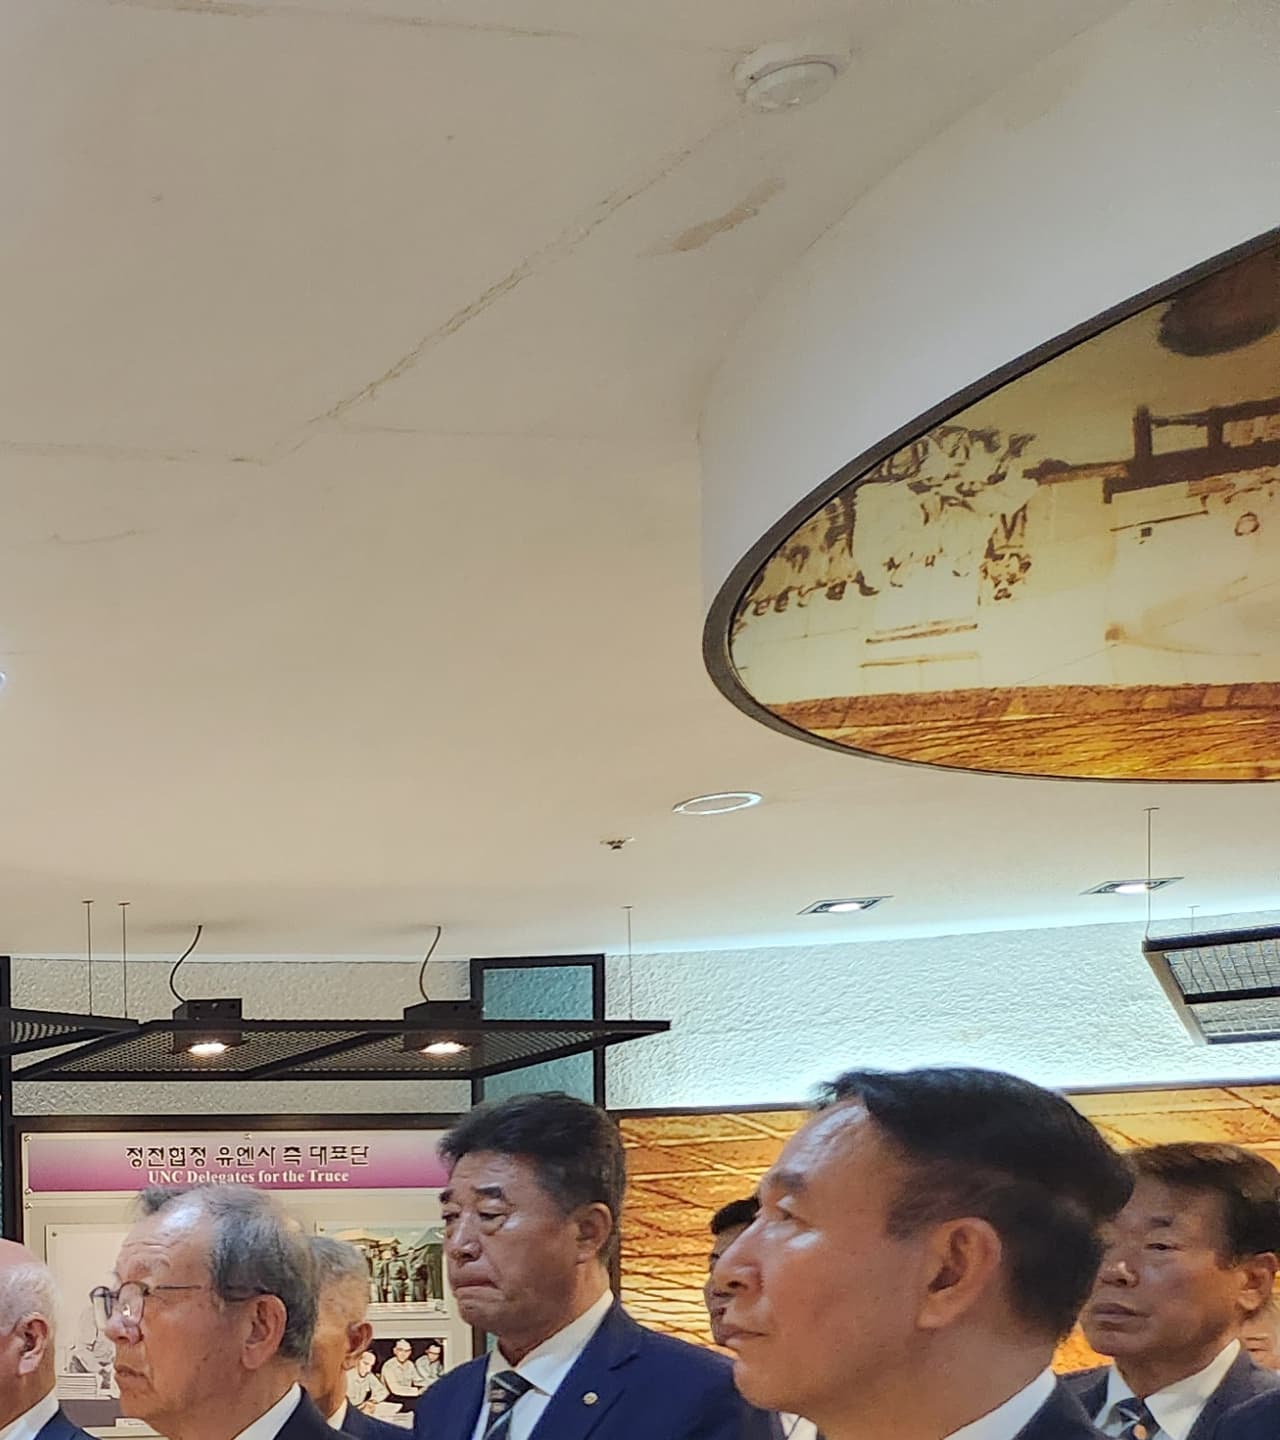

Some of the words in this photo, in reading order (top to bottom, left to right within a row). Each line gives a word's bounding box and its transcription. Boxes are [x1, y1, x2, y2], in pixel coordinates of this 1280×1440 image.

[126, 1146, 207, 1167] 정전협정
[216, 1146, 276, 1167] 유엔사
[283, 1146, 302, 1166] 측
[309, 1145, 369, 1166] 대표단
[149, 1170, 183, 1183] UNC
[187, 1170, 255, 1185] Delegates
[259, 1170, 280, 1183] for
[283, 1170, 305, 1183] the
[309, 1170, 349, 1183] Truce
